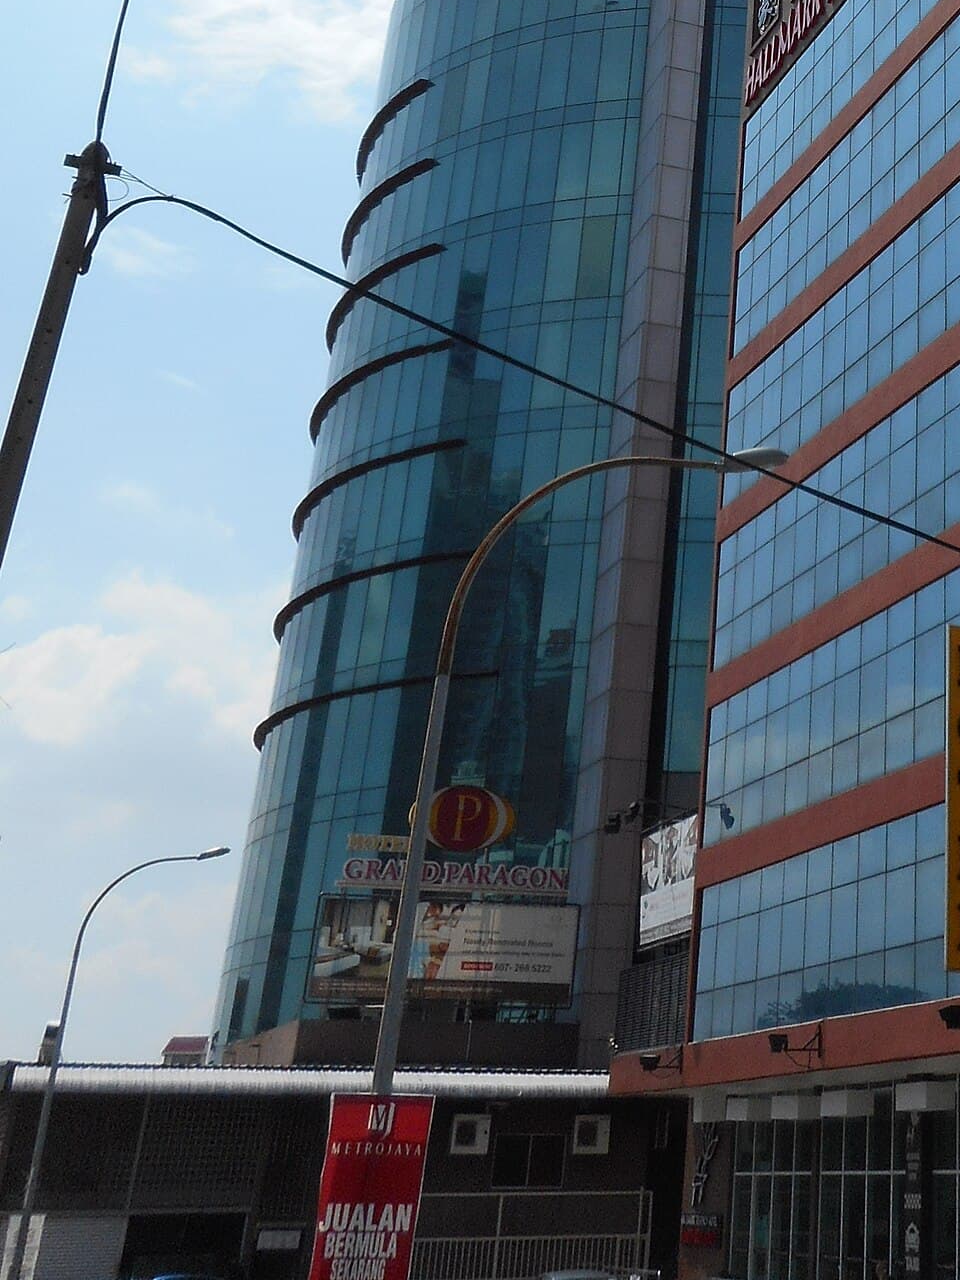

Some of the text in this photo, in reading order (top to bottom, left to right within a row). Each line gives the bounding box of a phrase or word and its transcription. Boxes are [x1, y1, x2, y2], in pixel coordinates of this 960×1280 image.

[453, 794, 482, 841] P
[347, 833, 410, 852] HOTE
[444, 861, 569, 890] PARAGON
[331, 1142, 422, 1157] METROJAYA
[318, 1202, 413, 1233] JUALAN
[323, 1231, 398, 1260] BERMULA
[329, 1258, 387, 1280] SEKARANG
